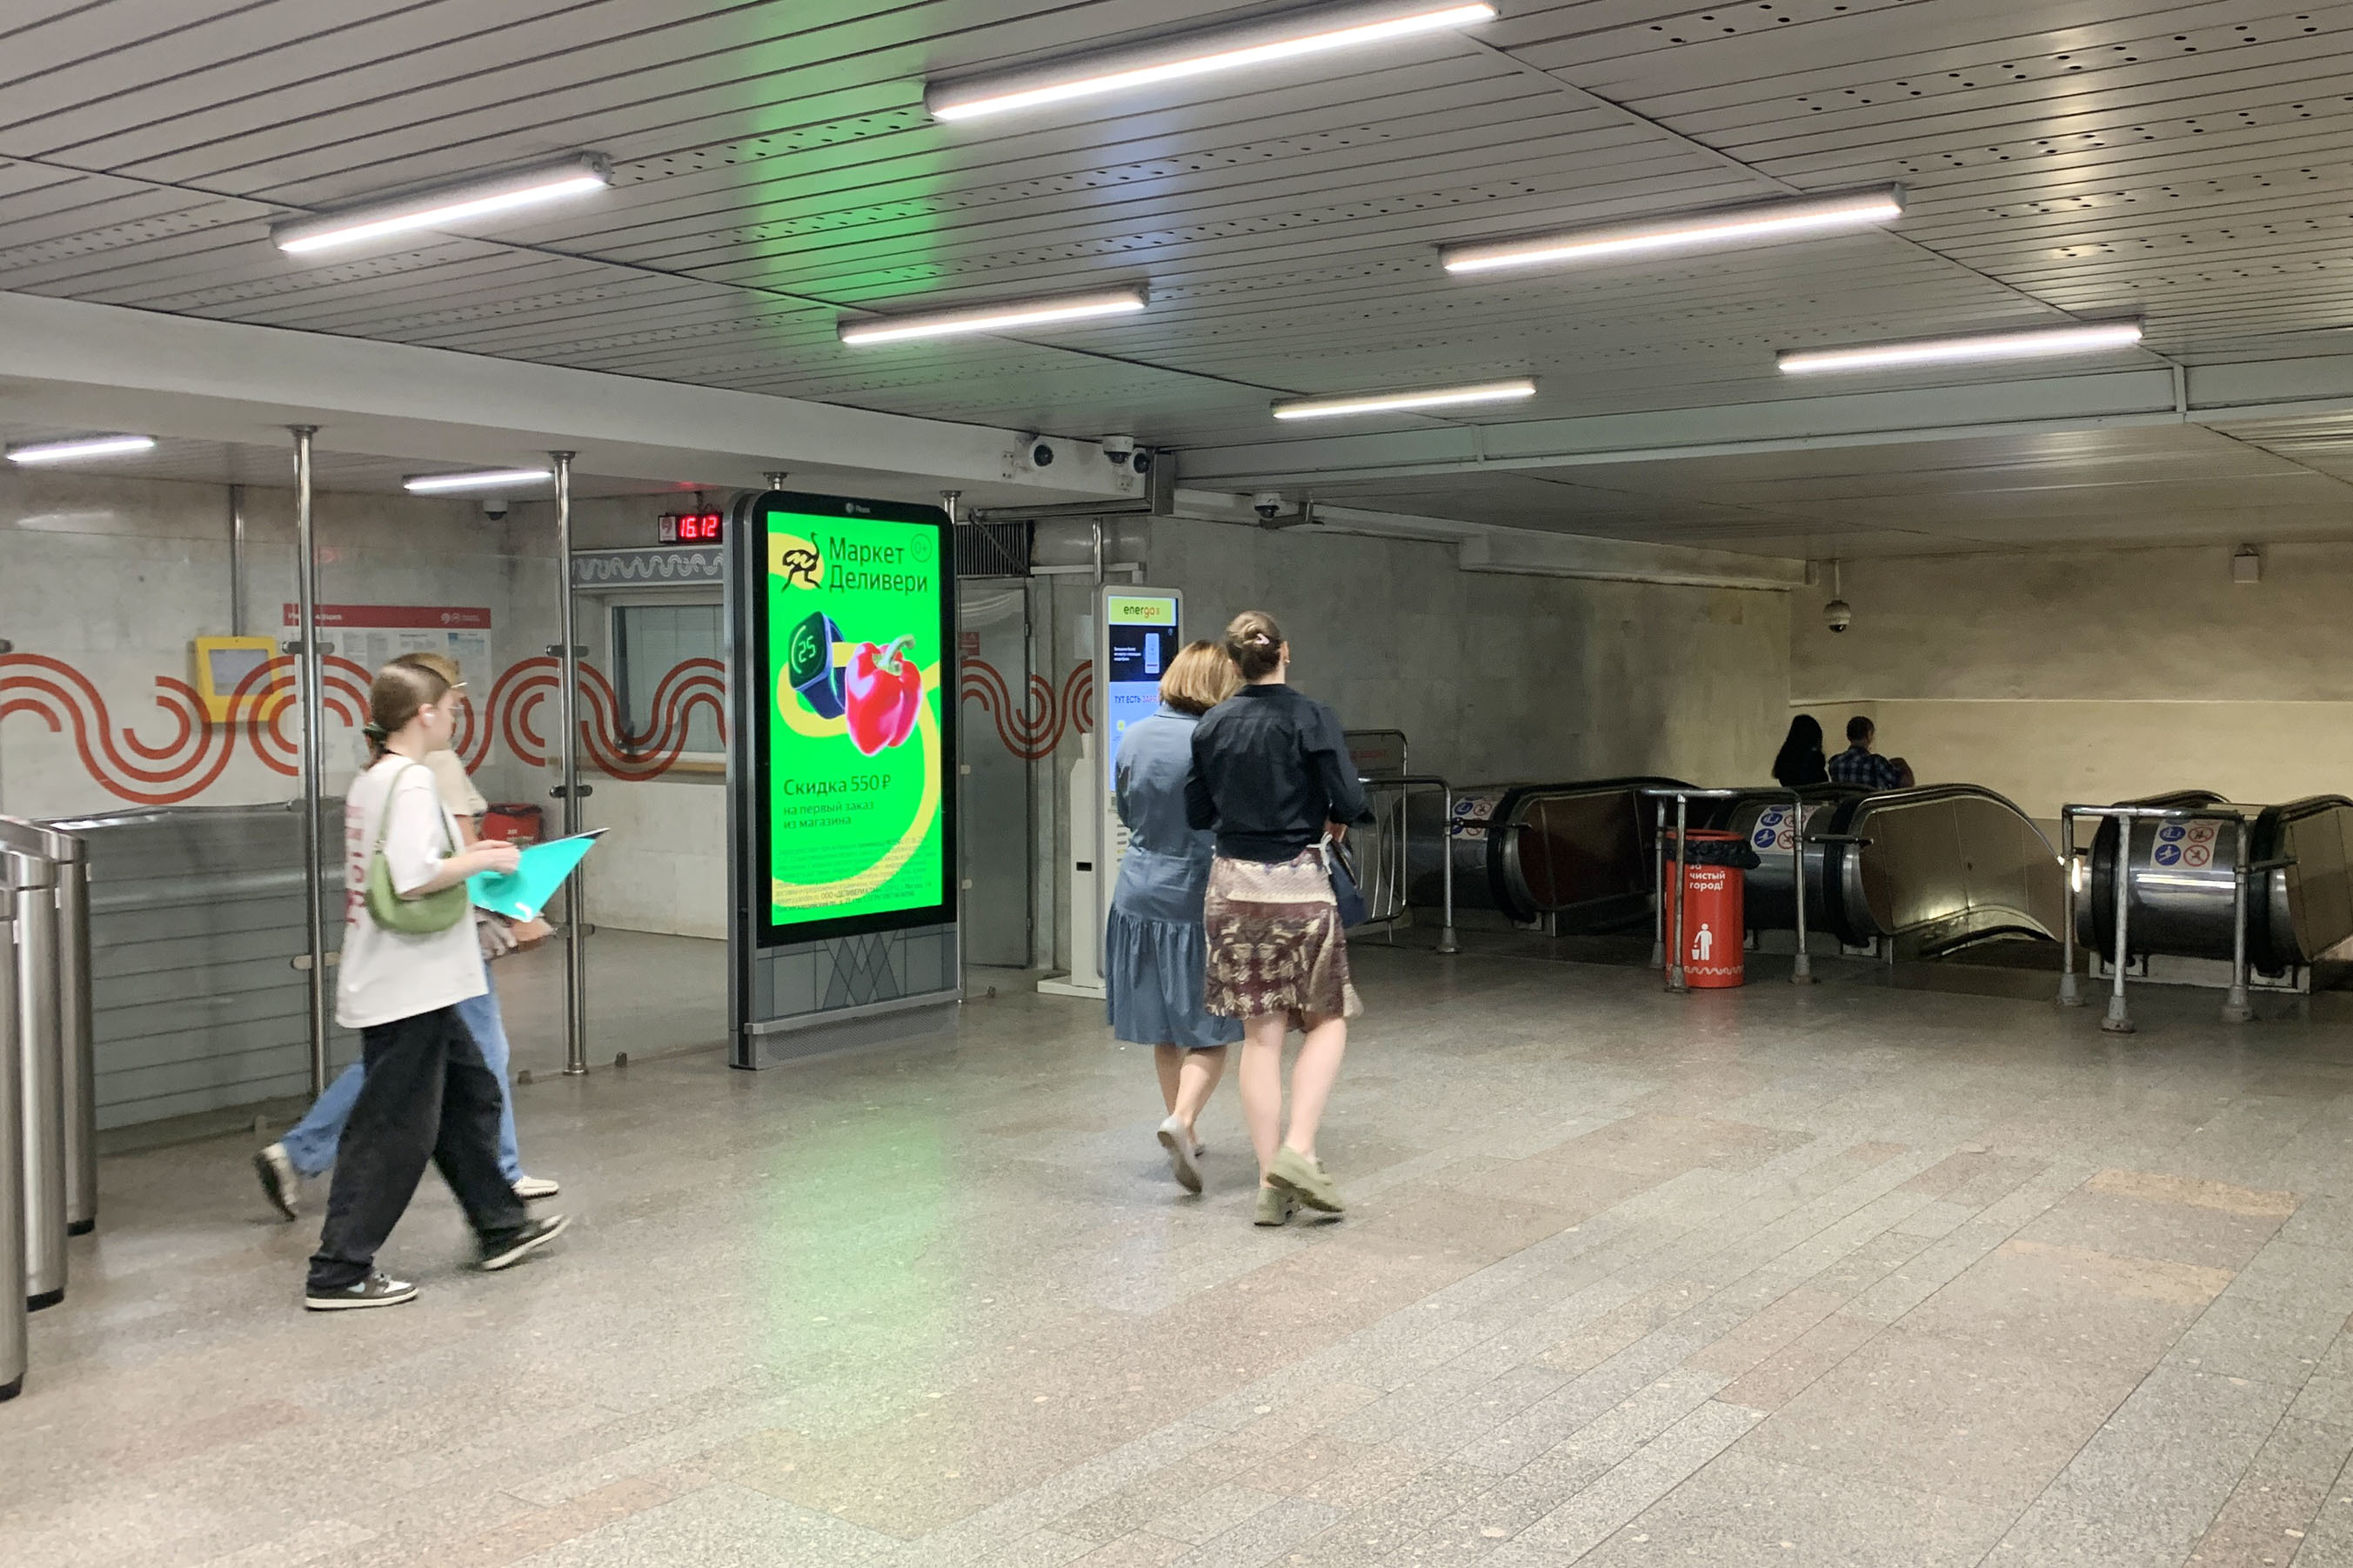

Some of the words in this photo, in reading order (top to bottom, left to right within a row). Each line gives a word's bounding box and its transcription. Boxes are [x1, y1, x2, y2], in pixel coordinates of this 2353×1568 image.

[829, 536, 905, 566] Маркет
[829, 564, 928, 596] Деливери
[798, 635, 817, 664] 25
[1114, 695, 1125, 704] ТУТ
[1126, 695, 1141, 704] ЕСТЬ
[783, 778, 847, 797] Скидка
[851, 774, 879, 792] 550
[783, 806, 798, 816] на
[799, 801, 843, 817] первый
[846, 800, 875, 812] заказ
[783, 820, 797, 830] из
[799, 816, 852, 829] магазина
[1689, 871, 1726, 880] чистый
[1689, 879, 1724, 892] город!
